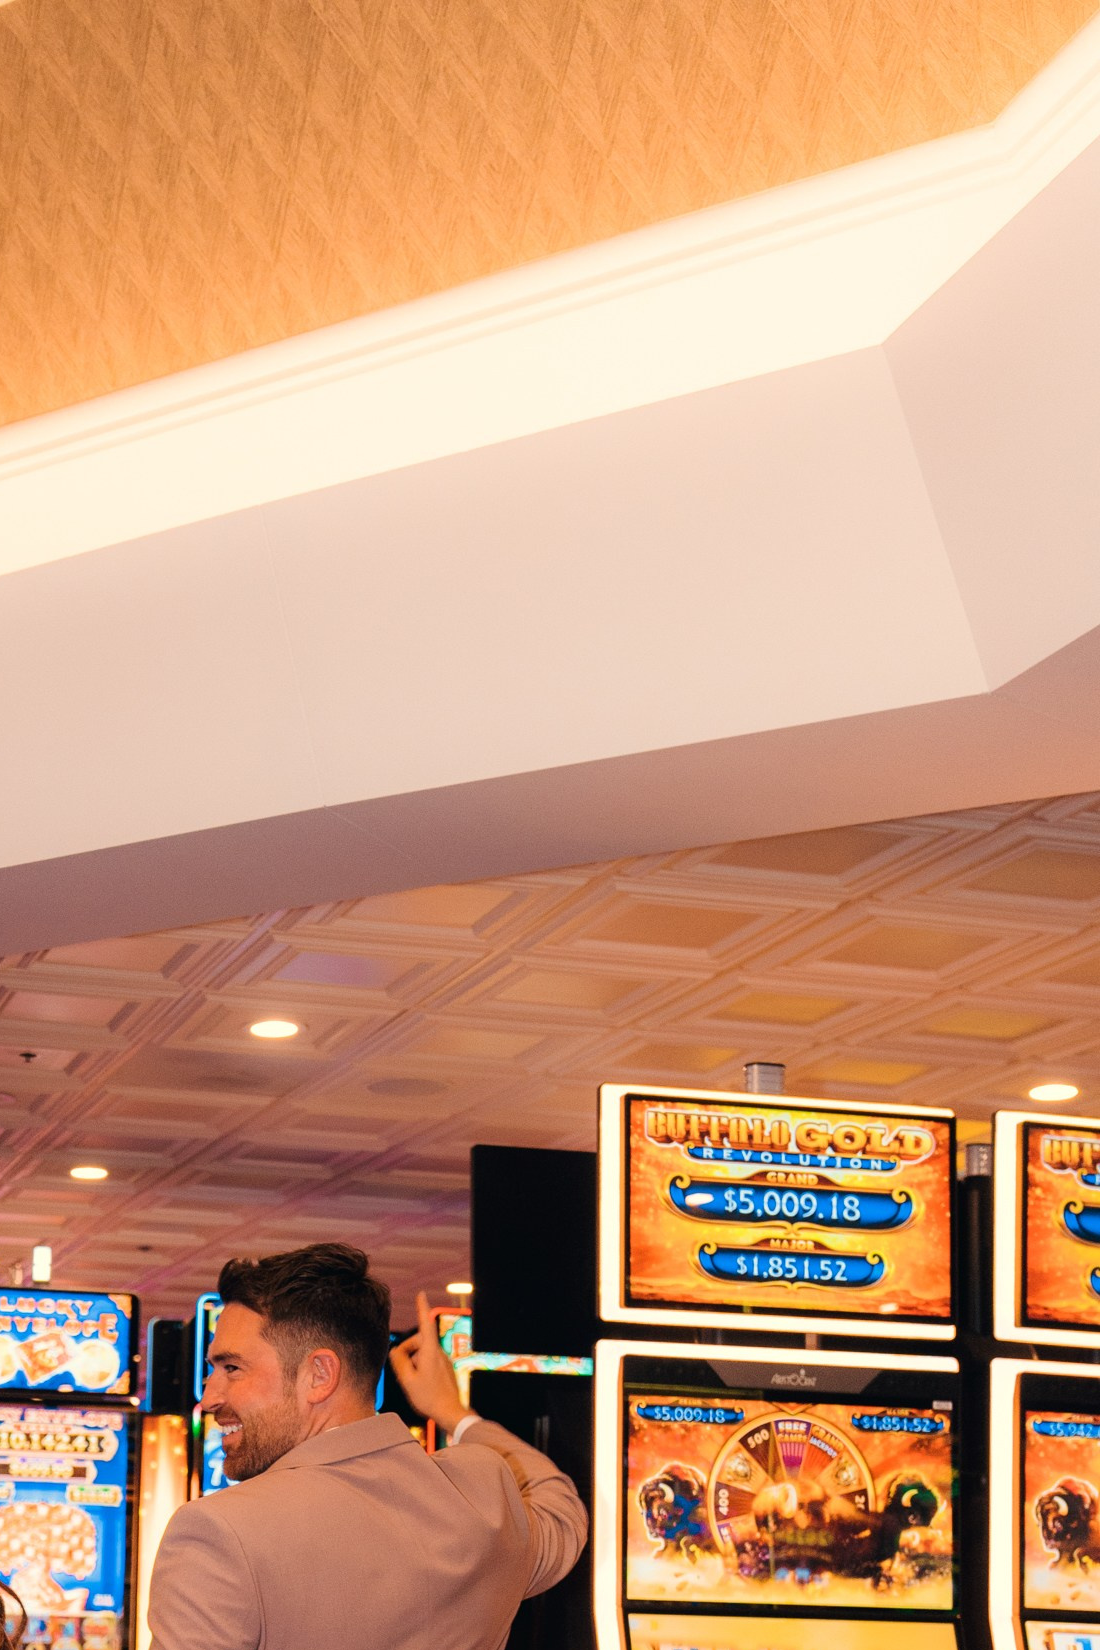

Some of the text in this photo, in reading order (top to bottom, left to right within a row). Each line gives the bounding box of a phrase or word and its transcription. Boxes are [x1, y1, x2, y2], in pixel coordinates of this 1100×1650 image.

[647, 1111, 934, 1159] BUFFALO GOLD
[702, 1147, 884, 1171] REVOLUTION
[766, 1171, 819, 1186] GRAND
[723, 1187, 861, 1221] $5,009.18
[769, 1238, 815, 1250] MAJOR
[736, 1254, 848, 1281] $1,851.52
[0, 1296, 93, 1320] LUCKY
[654, 1406, 726, 1423] $5,009.18
[747, 1429, 770, 1449] 500
